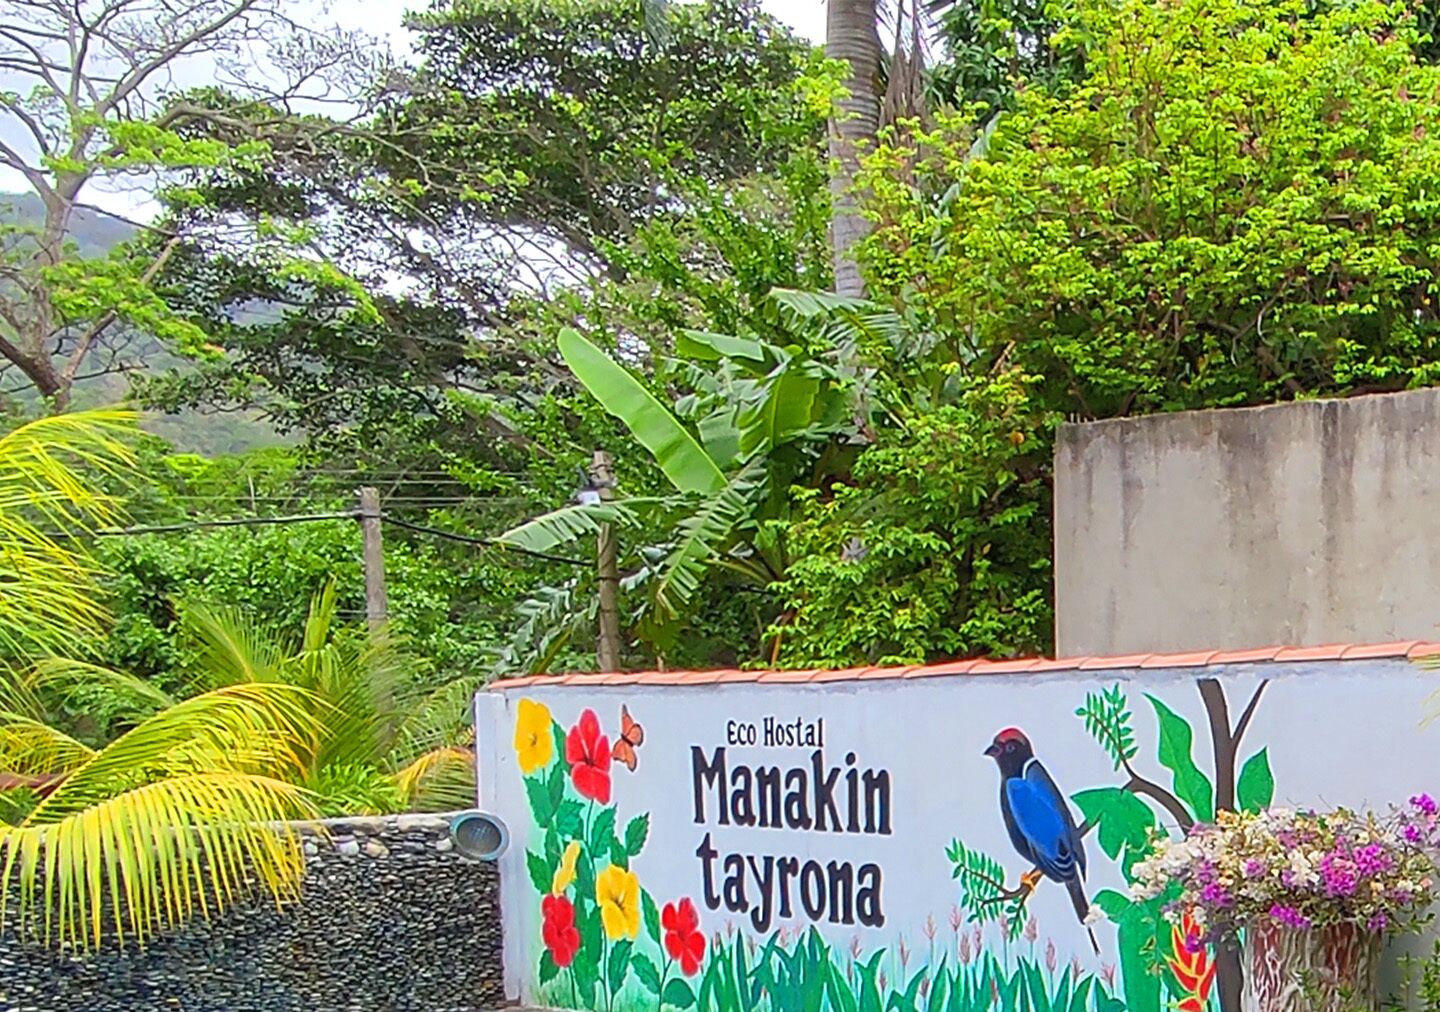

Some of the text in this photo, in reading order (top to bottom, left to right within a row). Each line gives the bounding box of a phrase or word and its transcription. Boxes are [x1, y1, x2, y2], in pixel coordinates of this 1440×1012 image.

[726, 716, 824, 748] Eco Hostal
[690, 745, 892, 836] Manakin
[695, 831, 886, 934] tayrona
